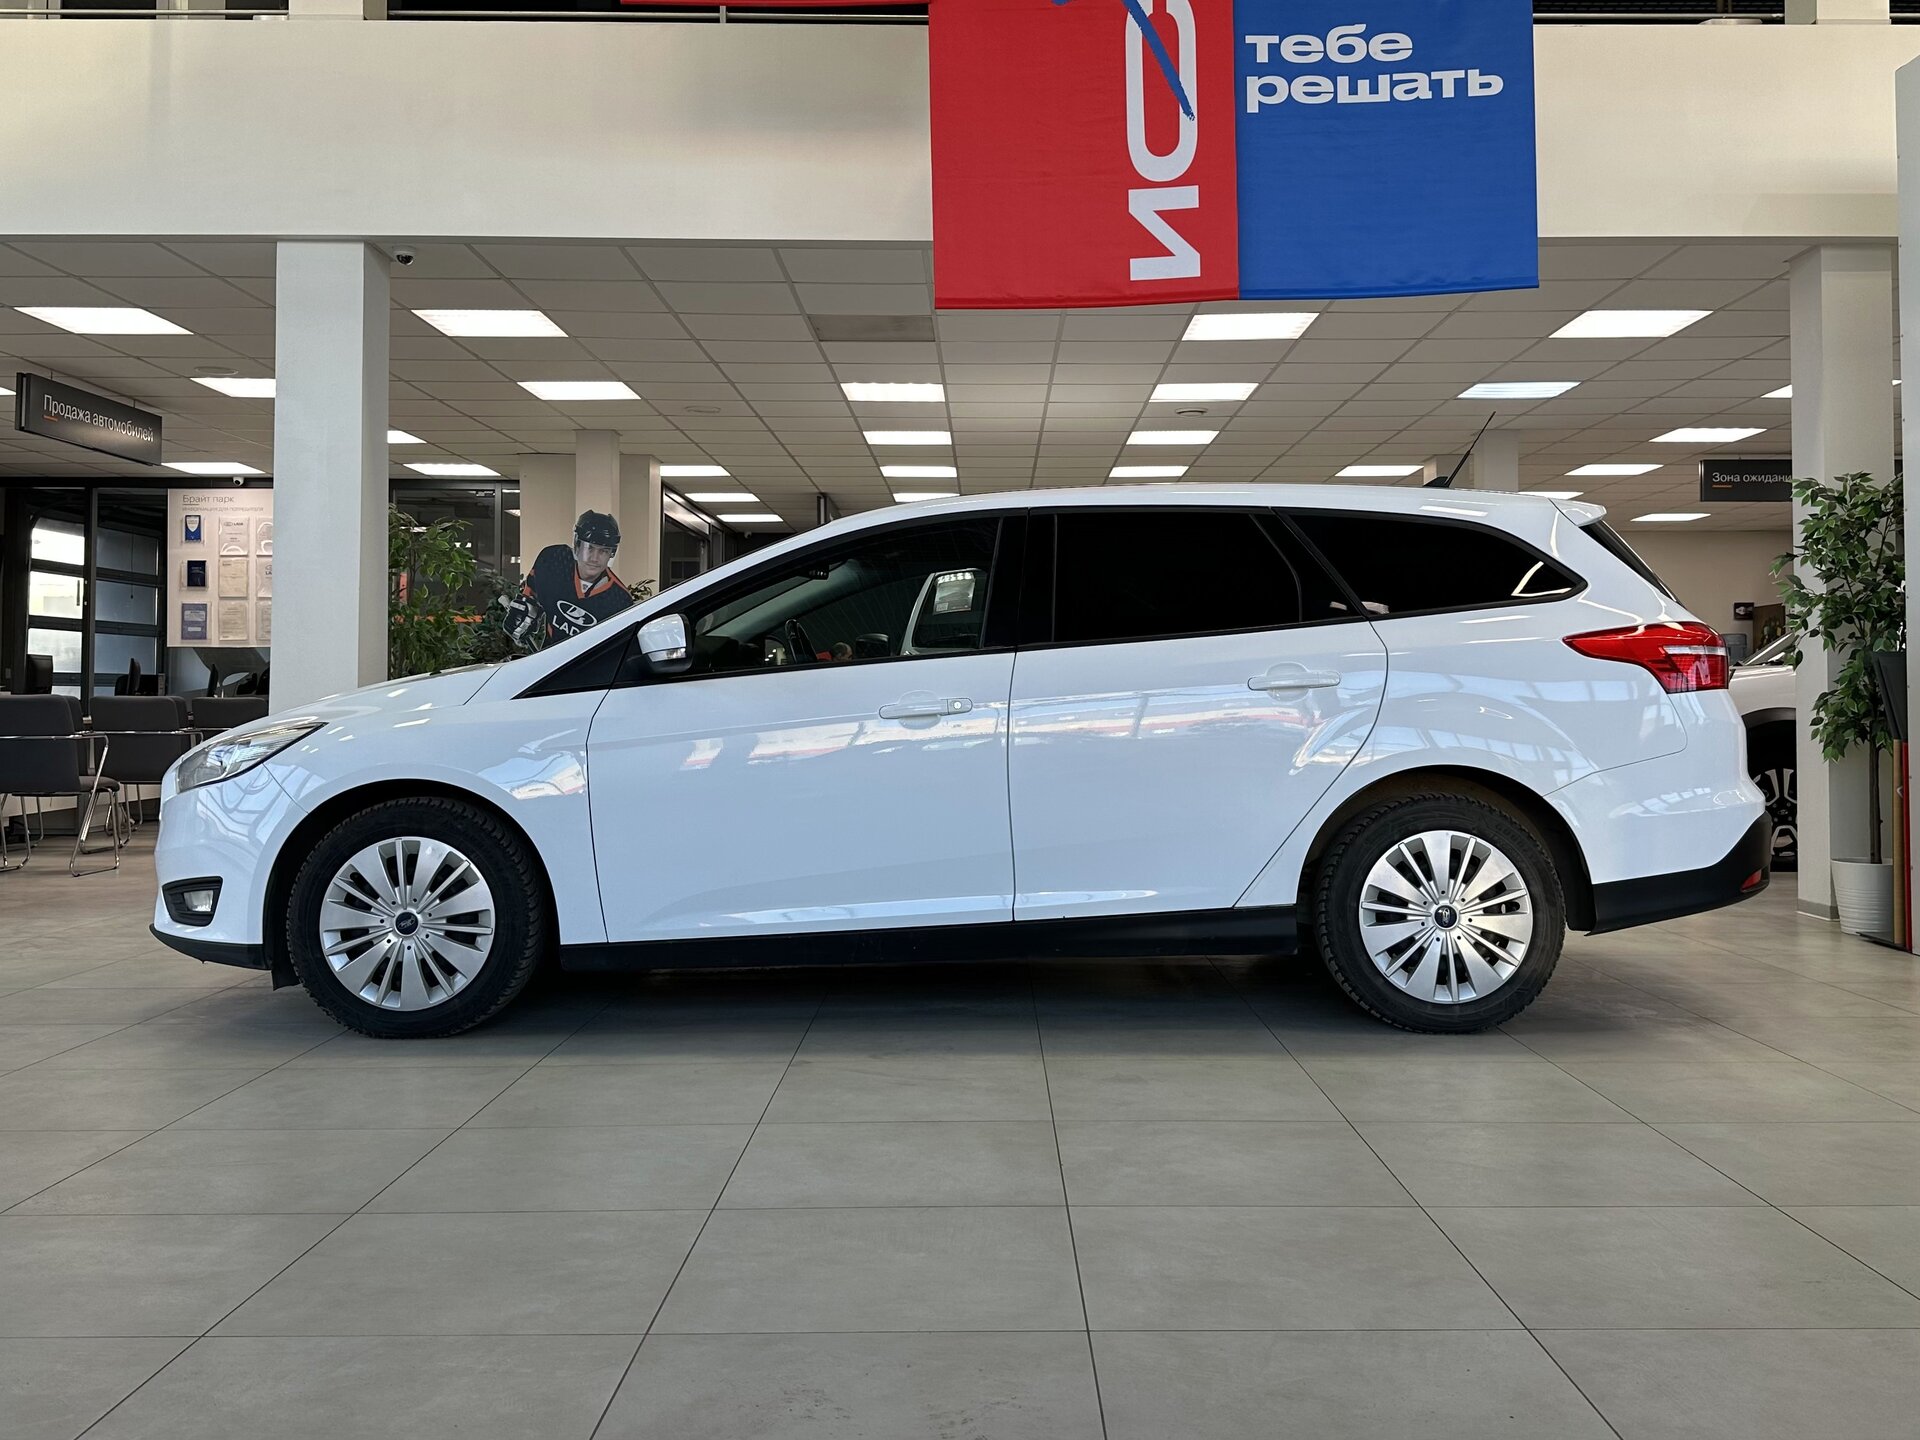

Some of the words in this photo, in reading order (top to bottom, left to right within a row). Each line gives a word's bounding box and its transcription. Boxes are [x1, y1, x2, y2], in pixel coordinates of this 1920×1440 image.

[1245, 23, 1414, 64] тебе
[1246, 68, 1504, 114] решать
[43, 394, 91, 424] Продажа
[92, 412, 154, 442] автомобилей
[1712, 472, 1741, 482] Зона
[182, 494, 210, 503] Брайт
[212, 496, 235, 504] парк
